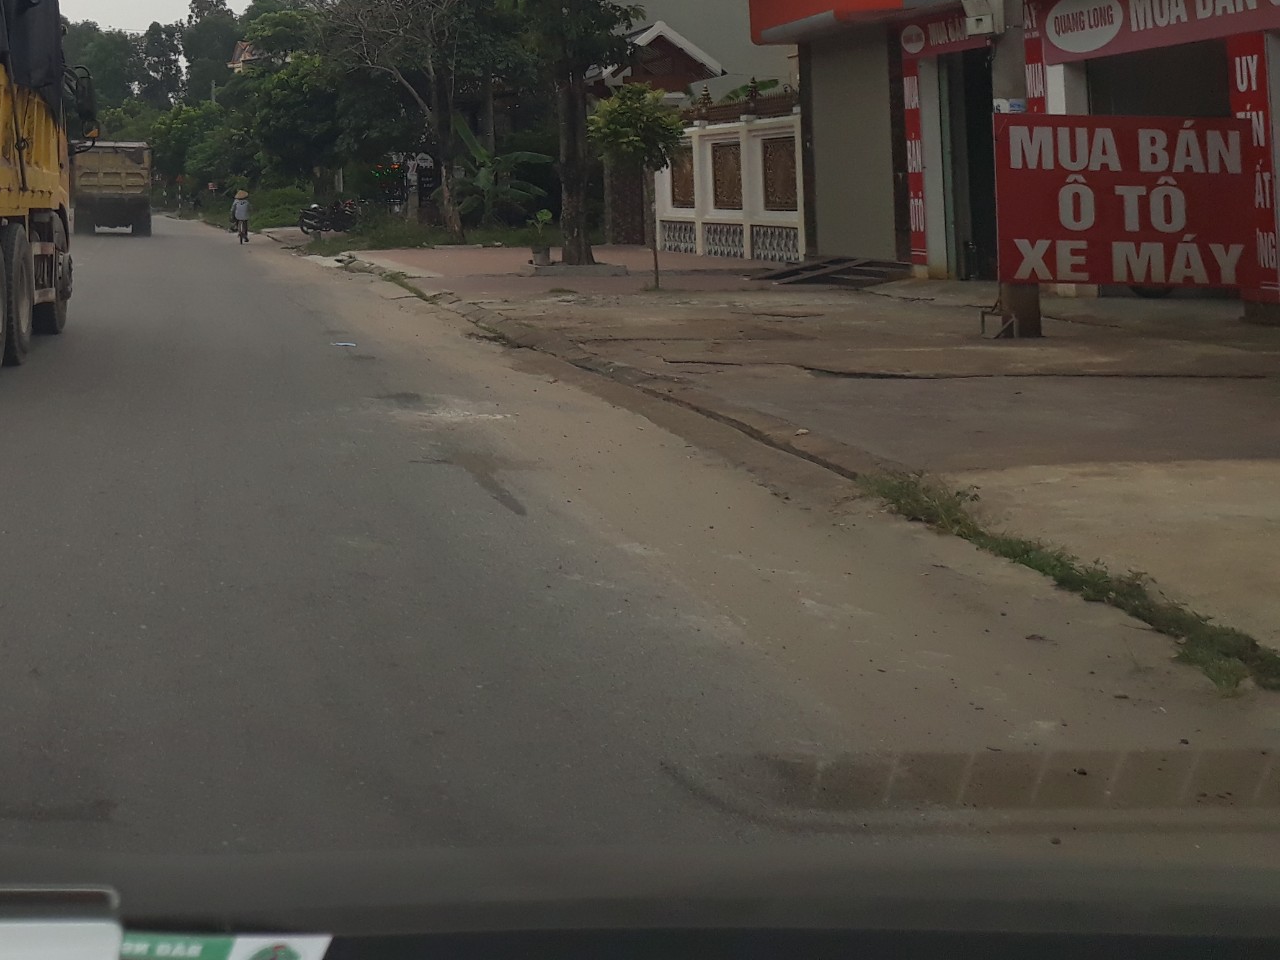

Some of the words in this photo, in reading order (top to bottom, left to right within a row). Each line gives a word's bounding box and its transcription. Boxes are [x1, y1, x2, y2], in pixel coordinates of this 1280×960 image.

[1053, 10, 1086, 36] QUANG
[1086, 3, 1115, 29] LONG
[1235, 54, 1258, 92] UY
[1009, 125, 1122, 172] MUA
[1138, 120, 1242, 174] BÁN
[1058, 174, 1095, 232] Ô
[1115, 176, 1186, 233] TÔ
[1014, 238, 1089, 281] XE
[1112, 234, 1244, 284] MÁY
